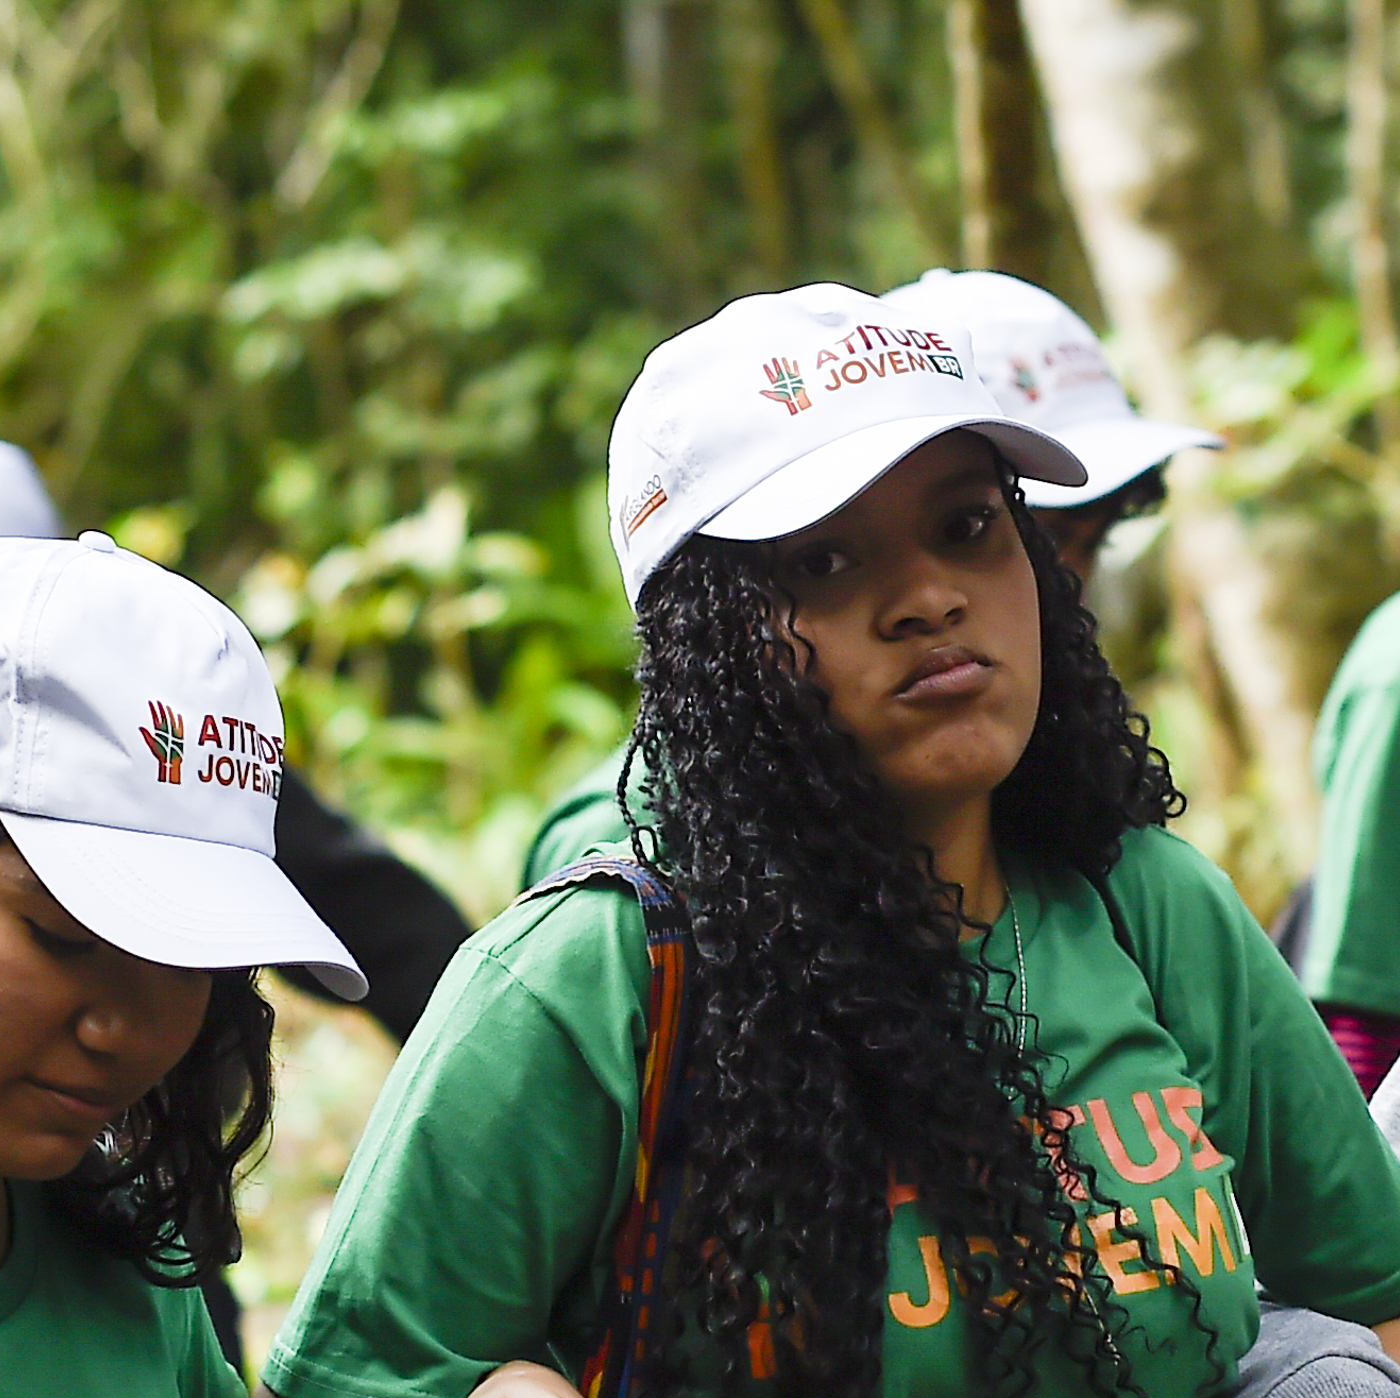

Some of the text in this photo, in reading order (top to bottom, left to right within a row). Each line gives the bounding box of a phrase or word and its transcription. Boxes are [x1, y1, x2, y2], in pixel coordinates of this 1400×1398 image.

[816, 325, 952, 369] ATITUDE
[825, 351, 962, 391] JOVEM BR
